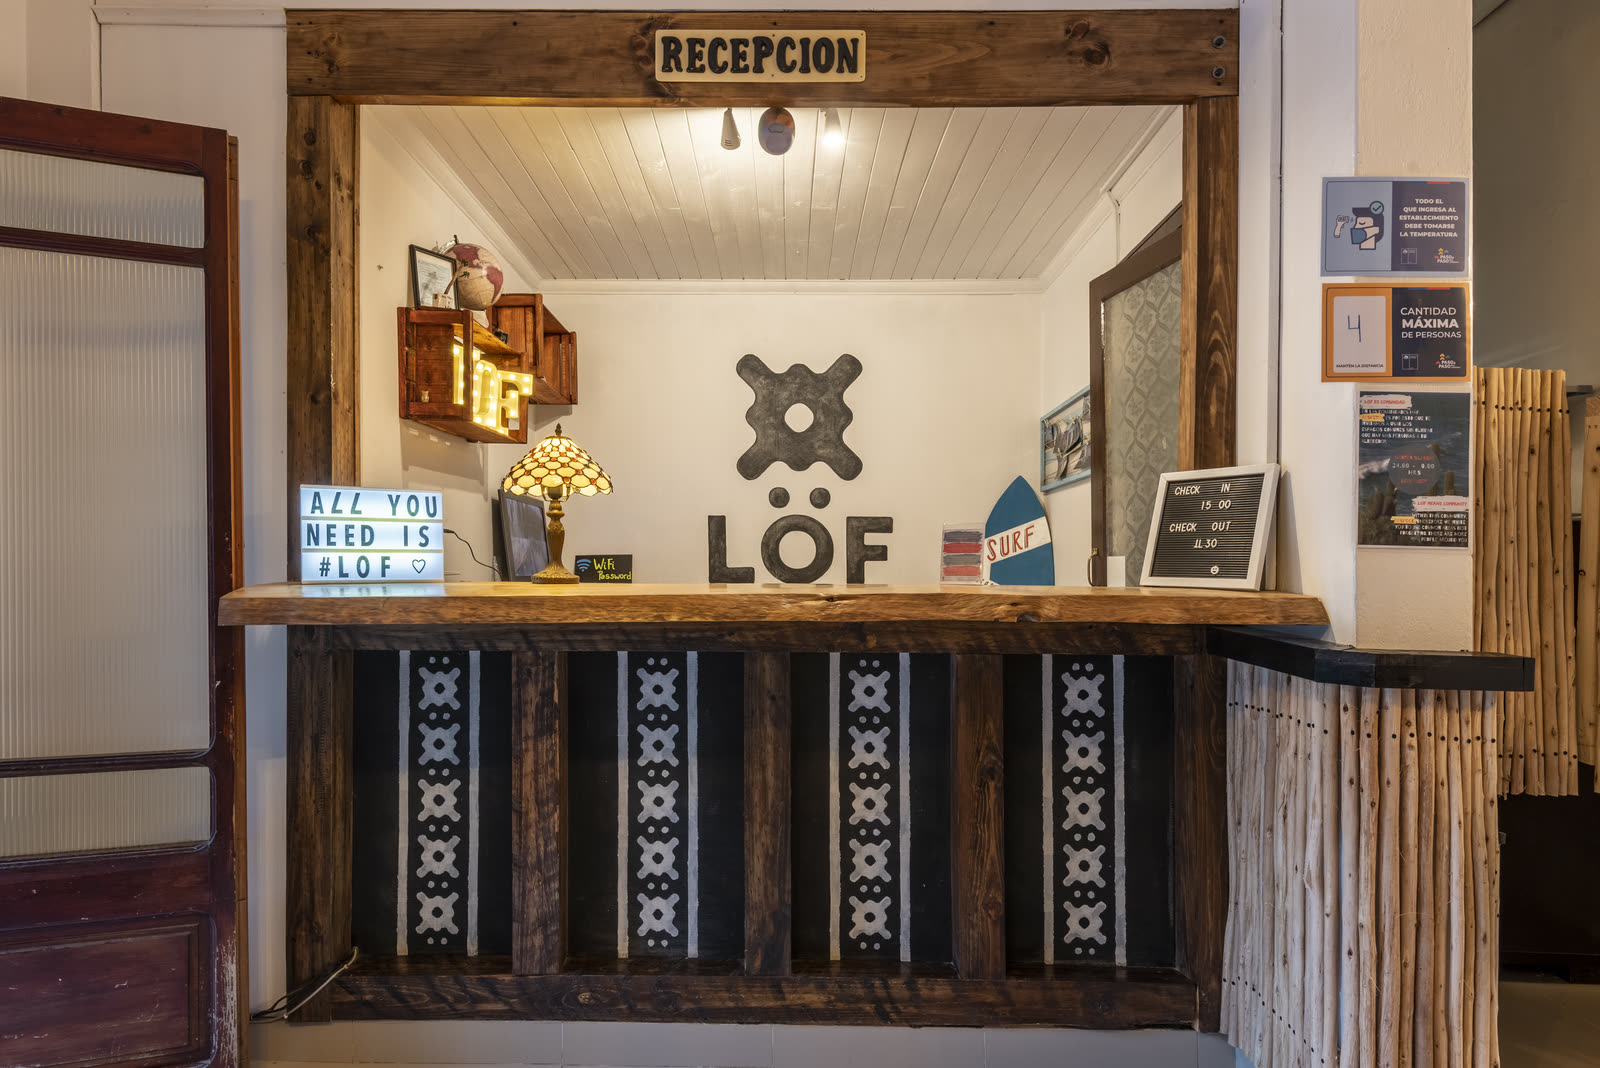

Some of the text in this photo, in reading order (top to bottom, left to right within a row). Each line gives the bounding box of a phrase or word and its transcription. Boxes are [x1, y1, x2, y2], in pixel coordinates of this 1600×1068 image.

[661, 36, 859, 74] RECEPCION
[1400, 307, 1456, 315] CANTIDAD
[1347, 314, 1361, 343] 4
[1402, 316, 1459, 328] MÁXIMA
[1174, 483, 1230, 496] CHECK IN
[310, 492, 437, 518] ALL YOU
[1201, 500, 1231, 510] 15 00
[306, 523, 429, 547] NEED IS
[1170, 522, 1231, 532] CHECK OUT
[987, 525, 1034, 561] SURF
[320, 555, 390, 578] #LOF
[594, 558, 615, 570] WiFi
